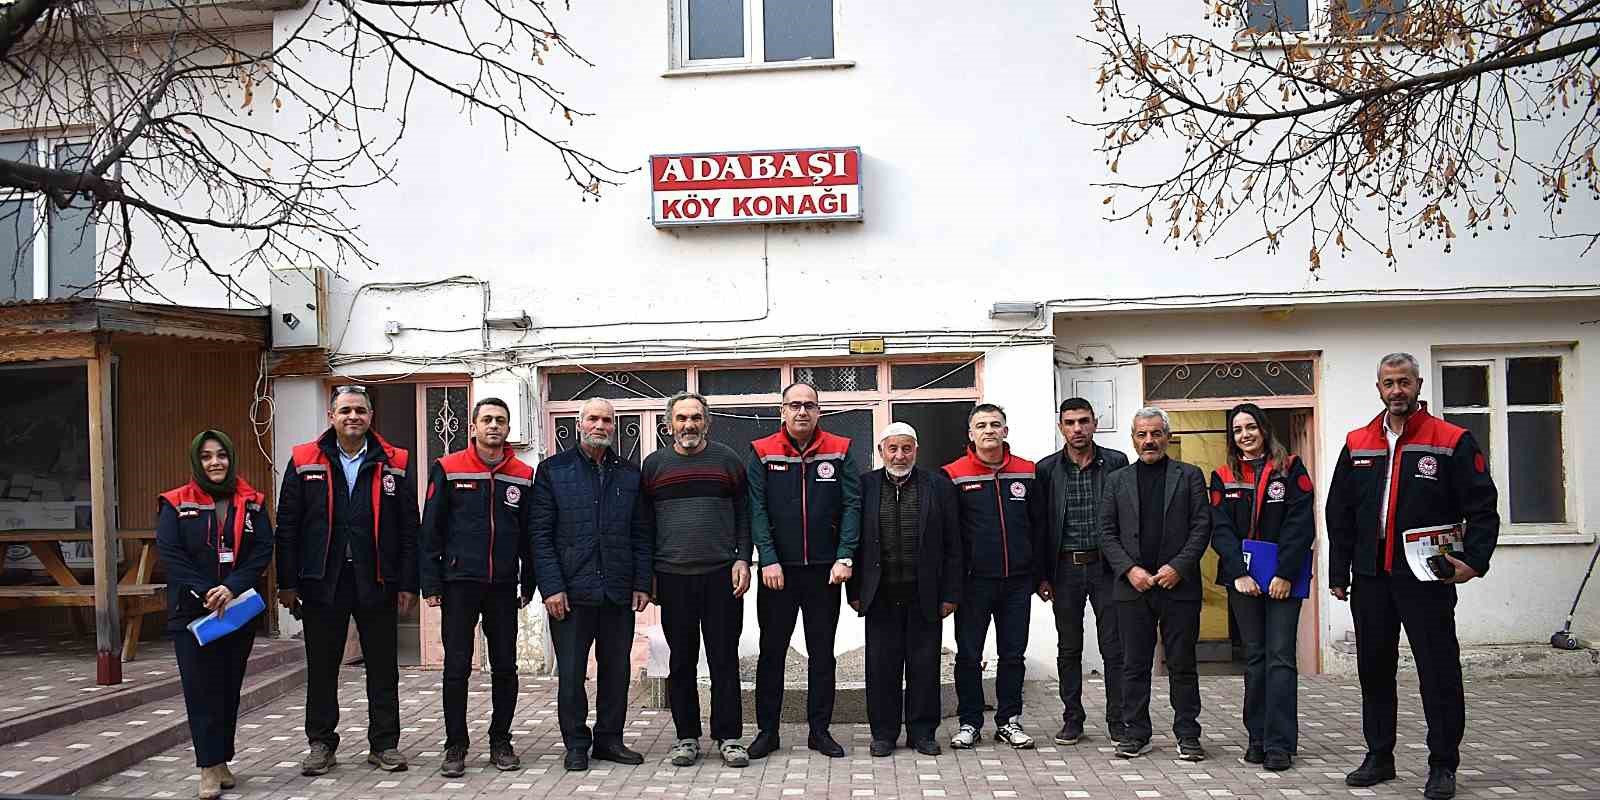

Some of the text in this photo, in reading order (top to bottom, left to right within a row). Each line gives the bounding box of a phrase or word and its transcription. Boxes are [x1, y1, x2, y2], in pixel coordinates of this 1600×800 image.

[659, 152, 848, 184] ADABAŞI
[662, 188, 848, 219] KÖY KONAĞI
